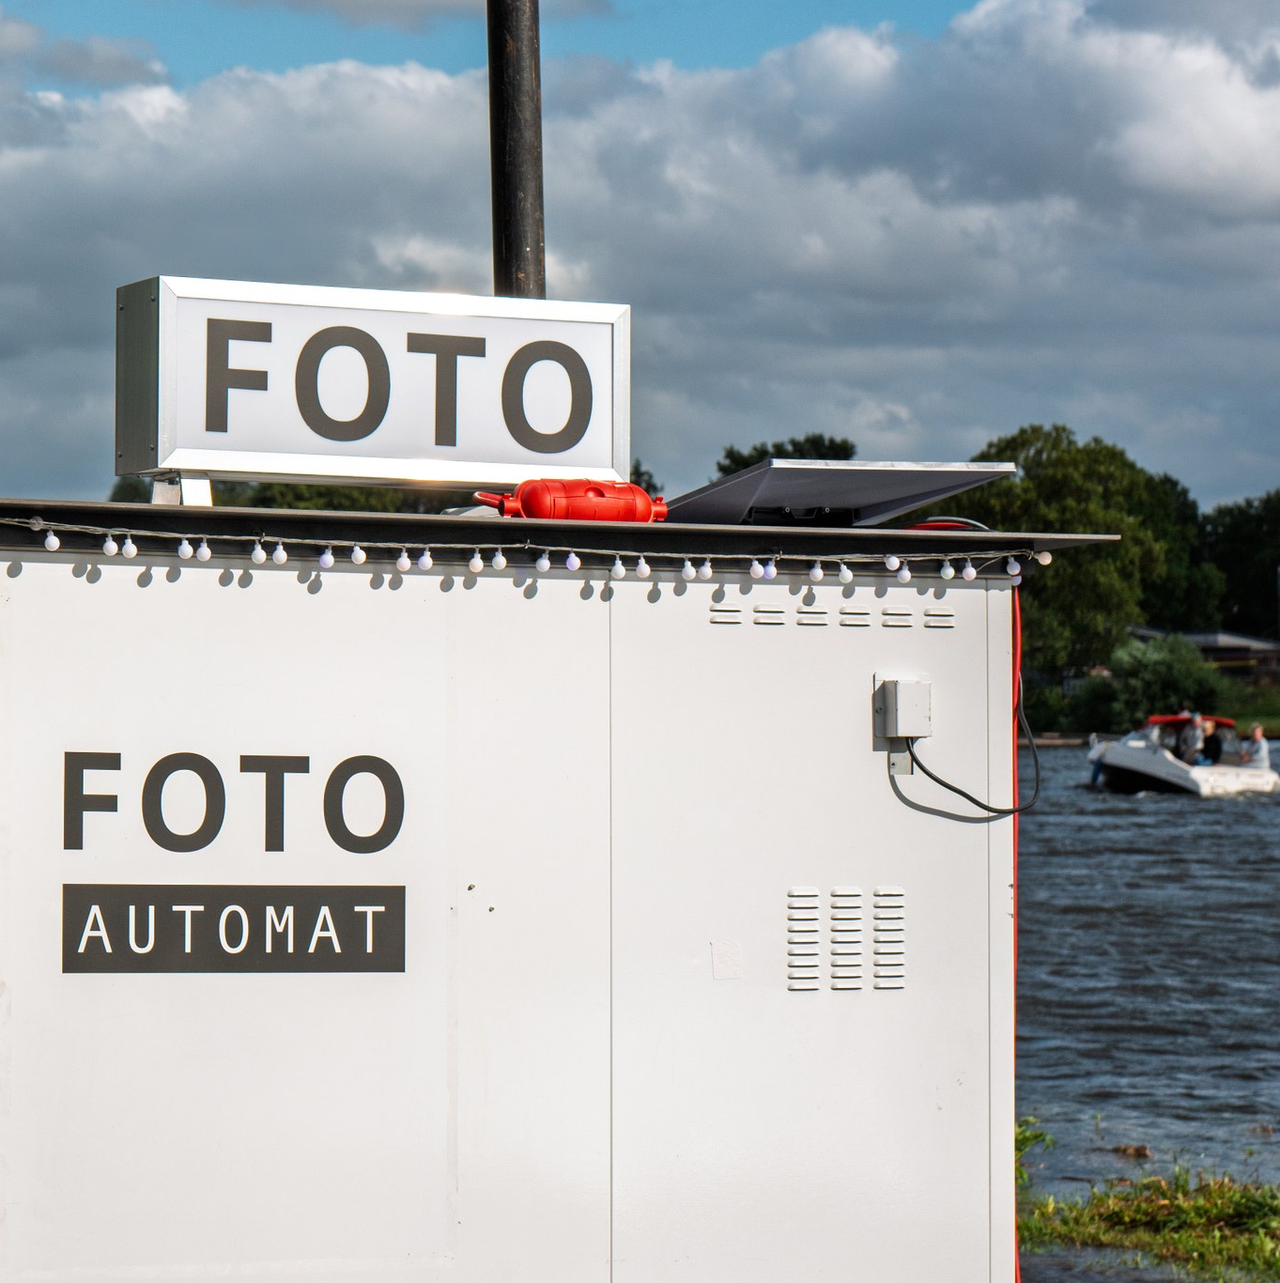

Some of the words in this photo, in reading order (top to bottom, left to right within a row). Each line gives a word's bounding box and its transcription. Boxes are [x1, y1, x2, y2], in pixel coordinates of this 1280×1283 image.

[205, 317, 593, 454] FOTO
[62, 751, 406, 854] FOTO
[77, 904, 387, 955] AUTOMAT
